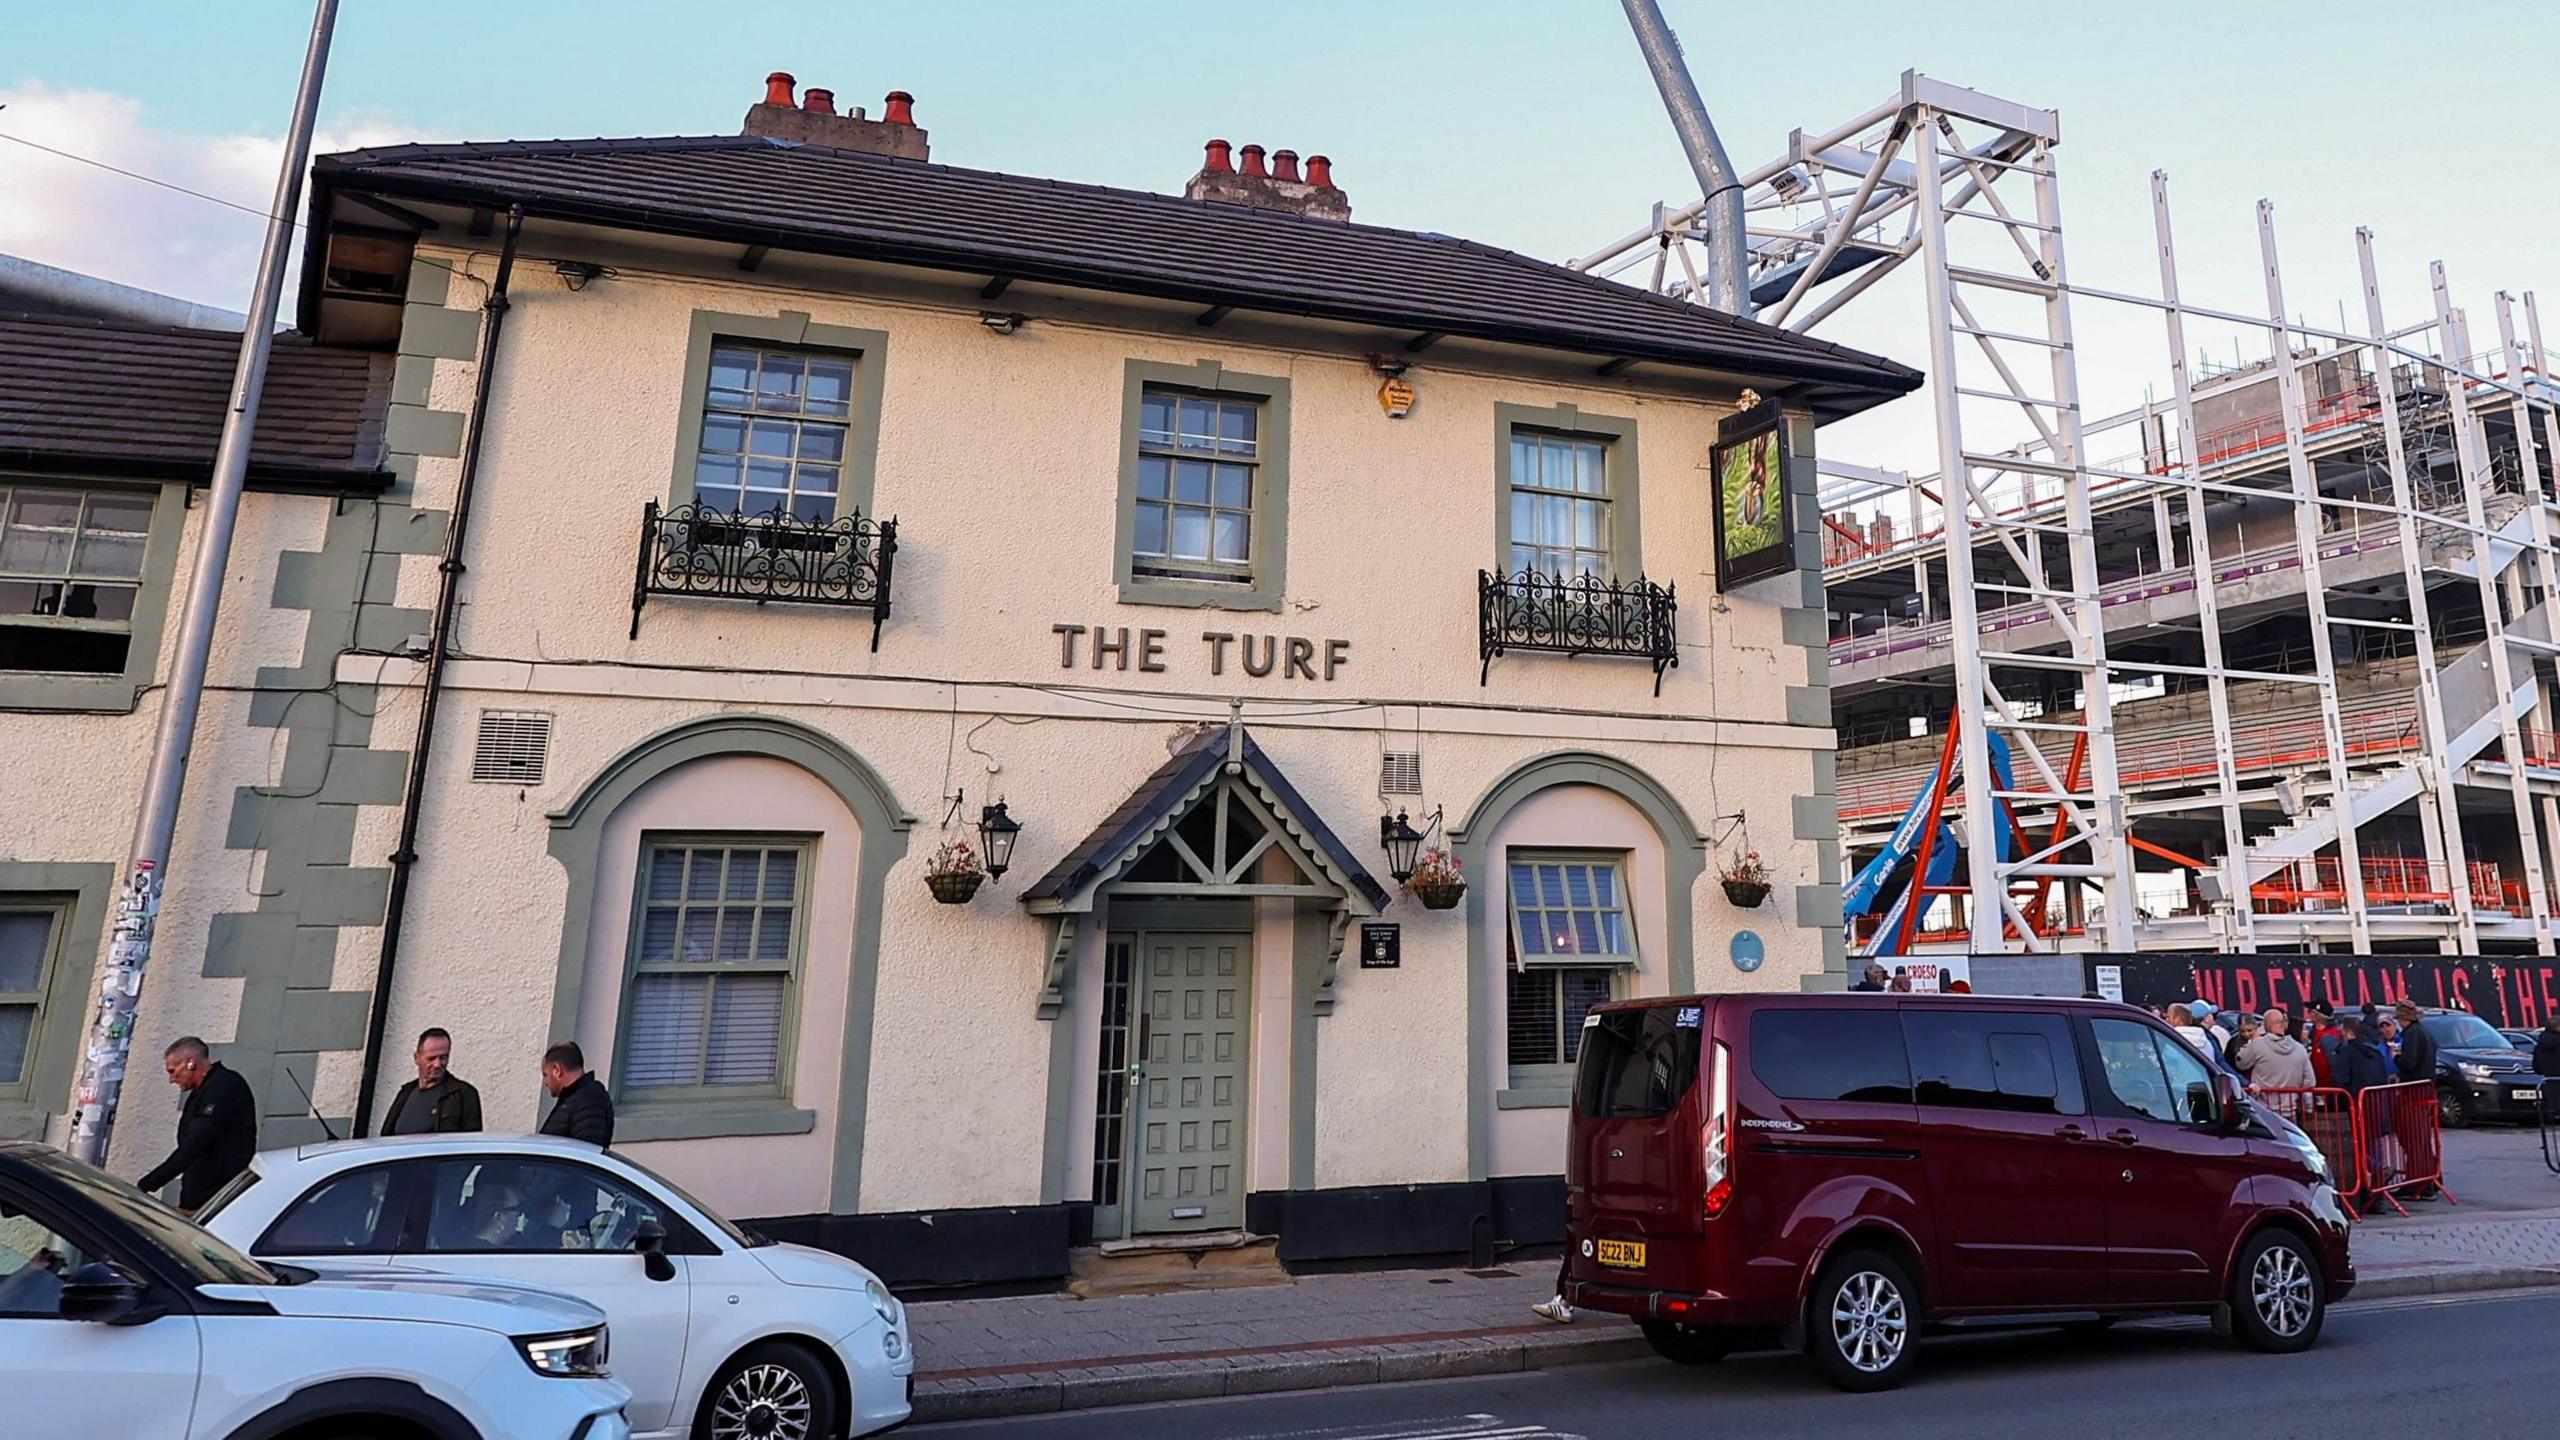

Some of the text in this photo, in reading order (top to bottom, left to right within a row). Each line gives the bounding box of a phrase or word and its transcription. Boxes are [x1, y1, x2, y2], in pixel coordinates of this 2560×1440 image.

[1052, 624, 1350, 681] THE TURF
[1873, 857, 1895, 886] Genie
[2194, 967, 2558, 1028] WREXHAM IS THE
[1741, 1119, 1791, 1129] INDEPENDENCE
[1601, 1241, 1642, 1263] SC22 BNJ
